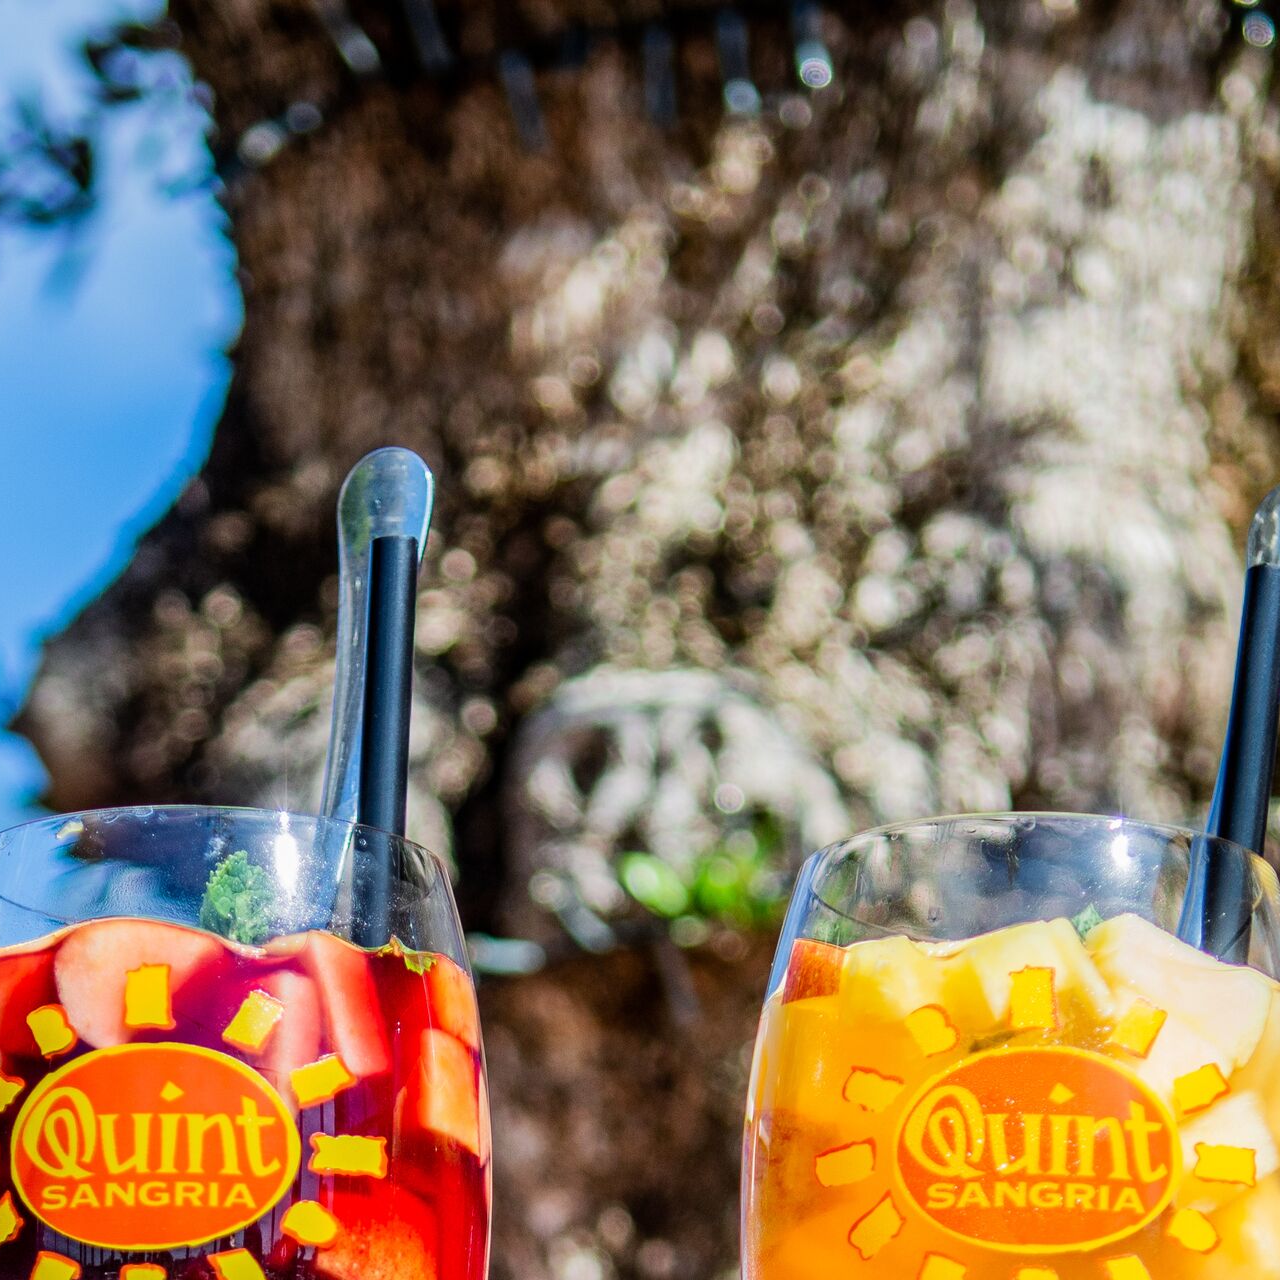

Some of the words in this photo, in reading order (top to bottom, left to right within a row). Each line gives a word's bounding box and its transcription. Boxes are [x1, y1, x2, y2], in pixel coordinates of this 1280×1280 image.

[22, 1080, 282, 1179] Quint
[903, 1082, 1169, 1184] Quint
[41, 1181, 257, 1210] SANGRIA
[926, 1181, 1146, 1214] SANGRIA
